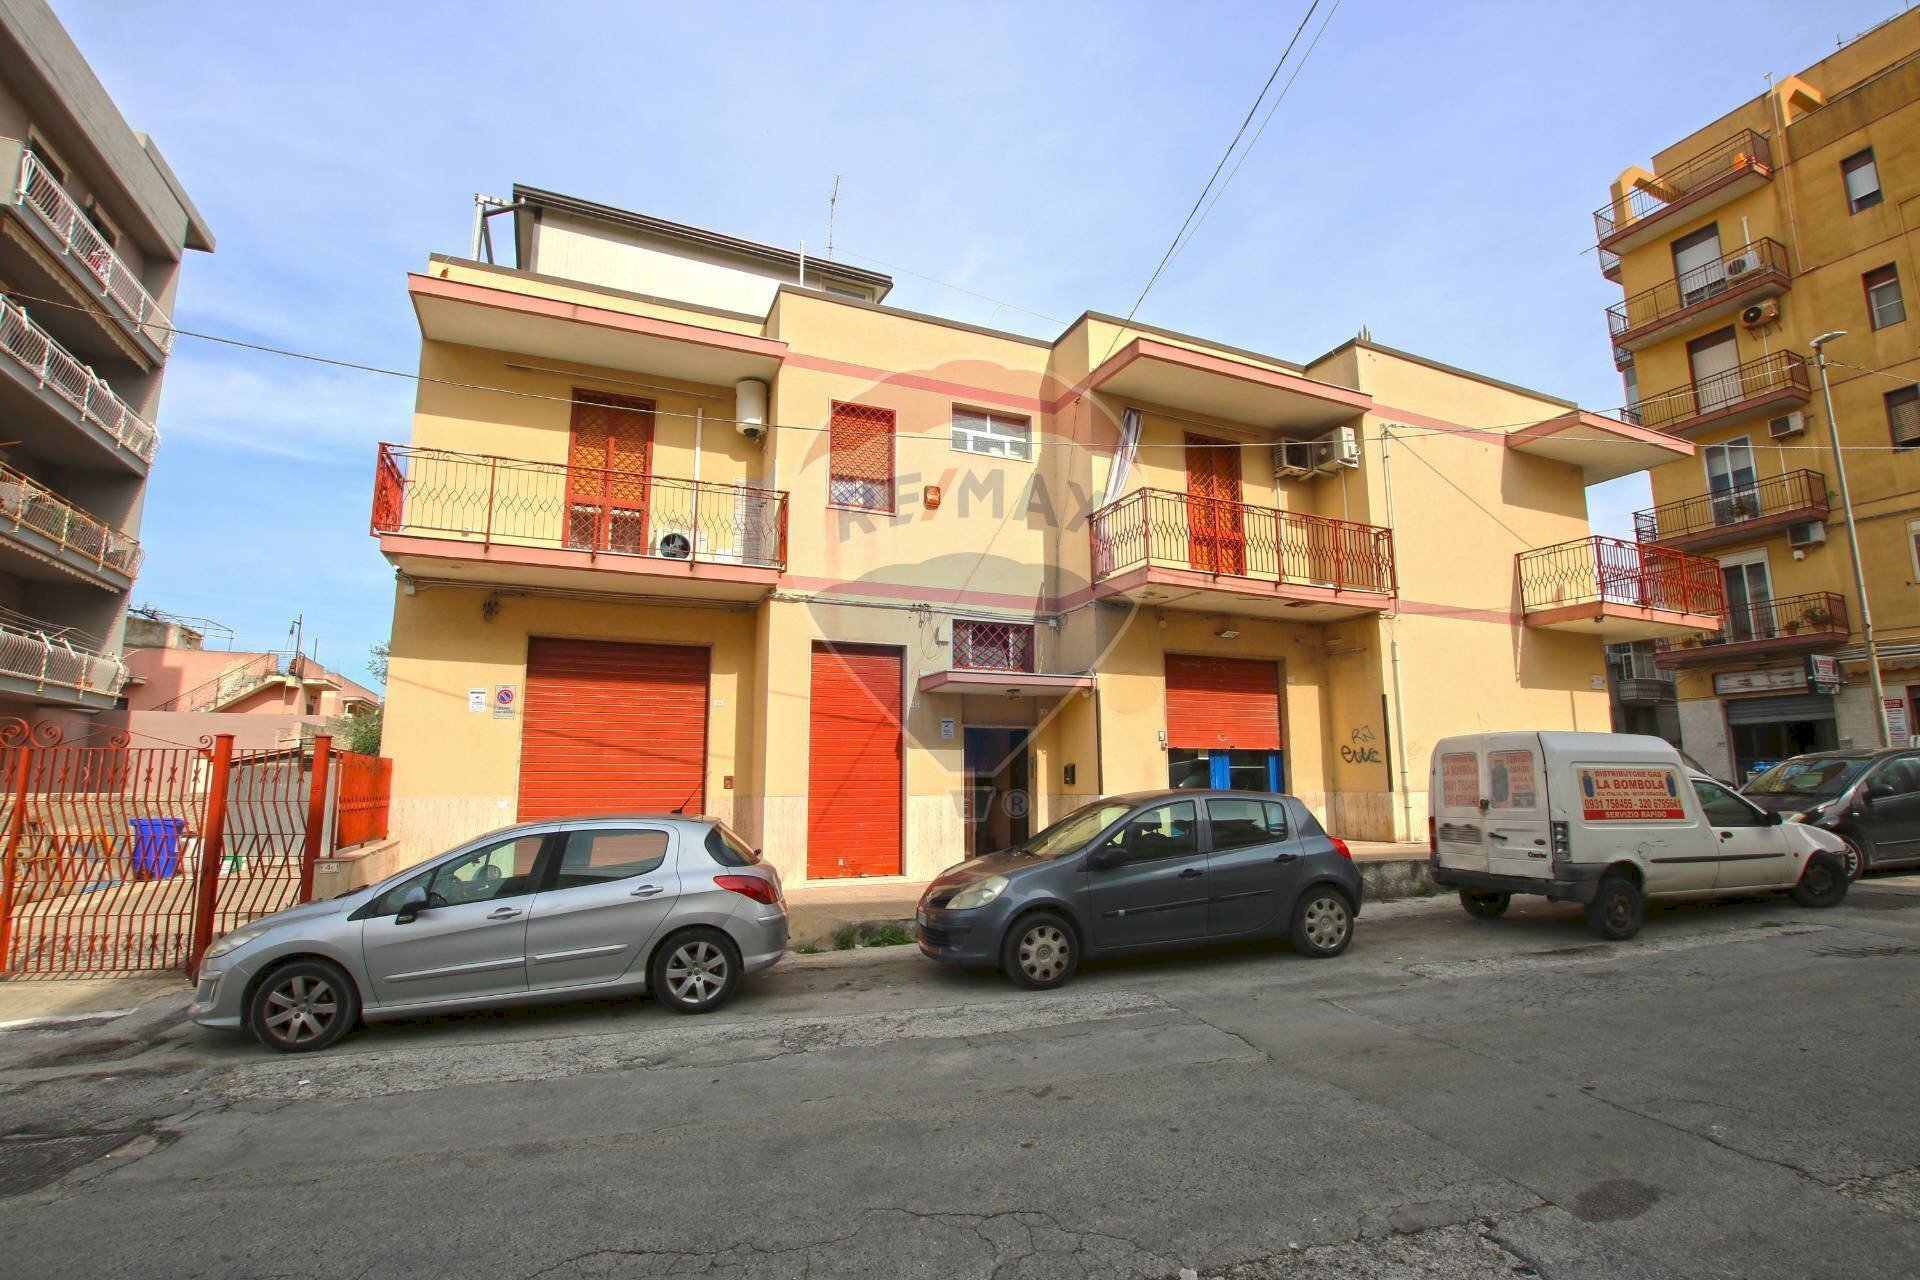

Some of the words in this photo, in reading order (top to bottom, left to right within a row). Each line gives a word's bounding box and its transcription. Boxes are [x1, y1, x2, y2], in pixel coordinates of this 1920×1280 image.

[1596, 780, 1610, 789] LA
[1613, 780, 1664, 789] BOMBOLA
[1584, 799, 1603, 808] 0931
[1605, 799, 1632, 808] 758455
[1638, 799, 1652, 808] 320
